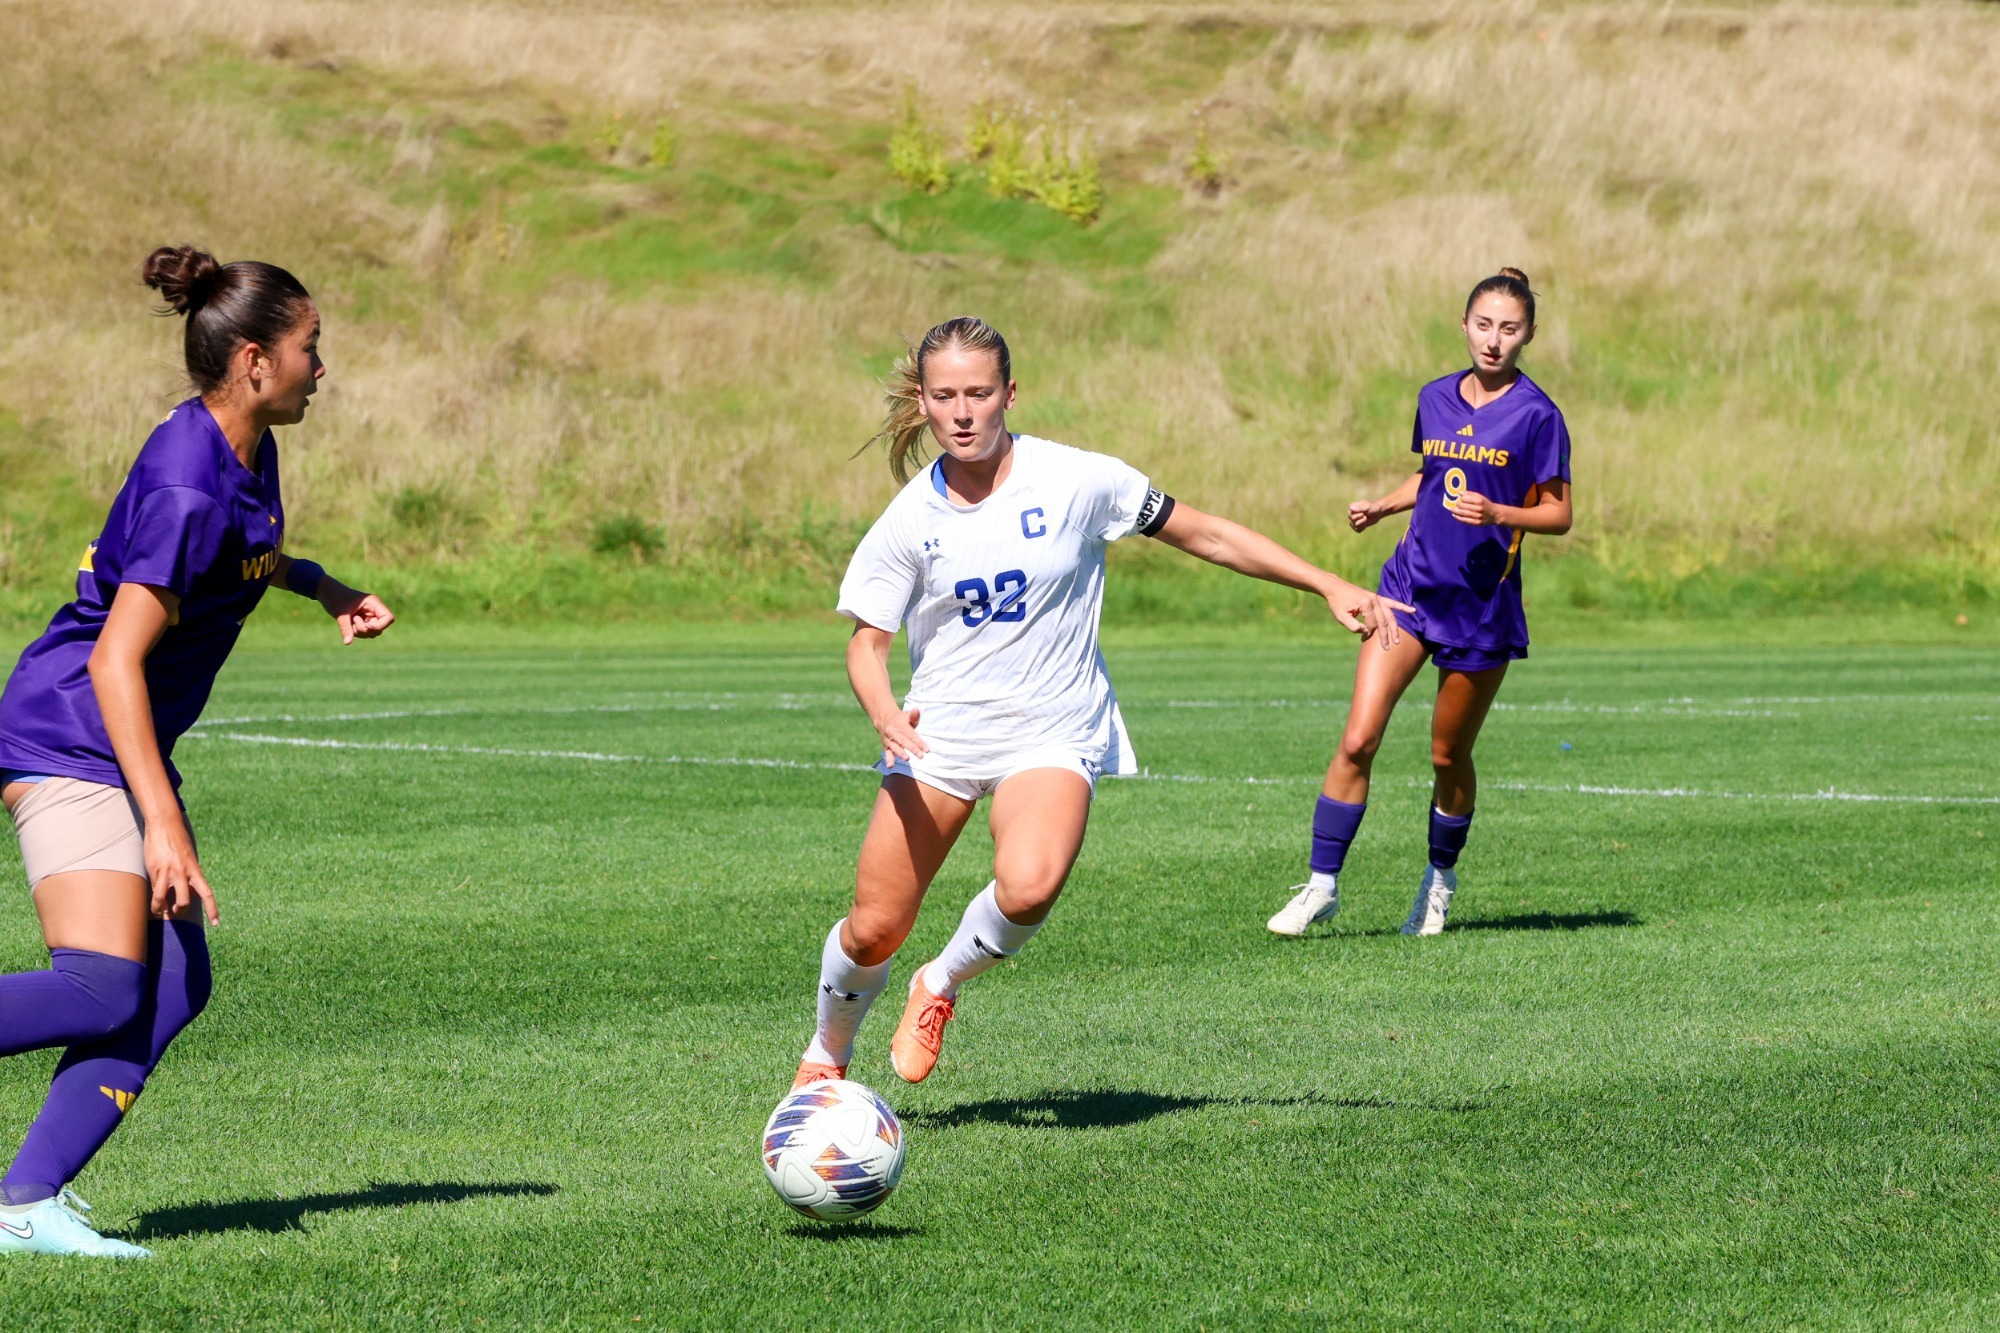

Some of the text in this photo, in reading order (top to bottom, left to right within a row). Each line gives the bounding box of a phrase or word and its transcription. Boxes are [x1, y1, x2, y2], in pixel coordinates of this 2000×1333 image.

[1422, 439, 1509, 467] WILLIAMS
[1136, 487, 1162, 527] CAPTA
[1443, 467, 1467, 511] 9
[1020, 506, 1047, 539] C
[954, 569, 1027, 628] 32
